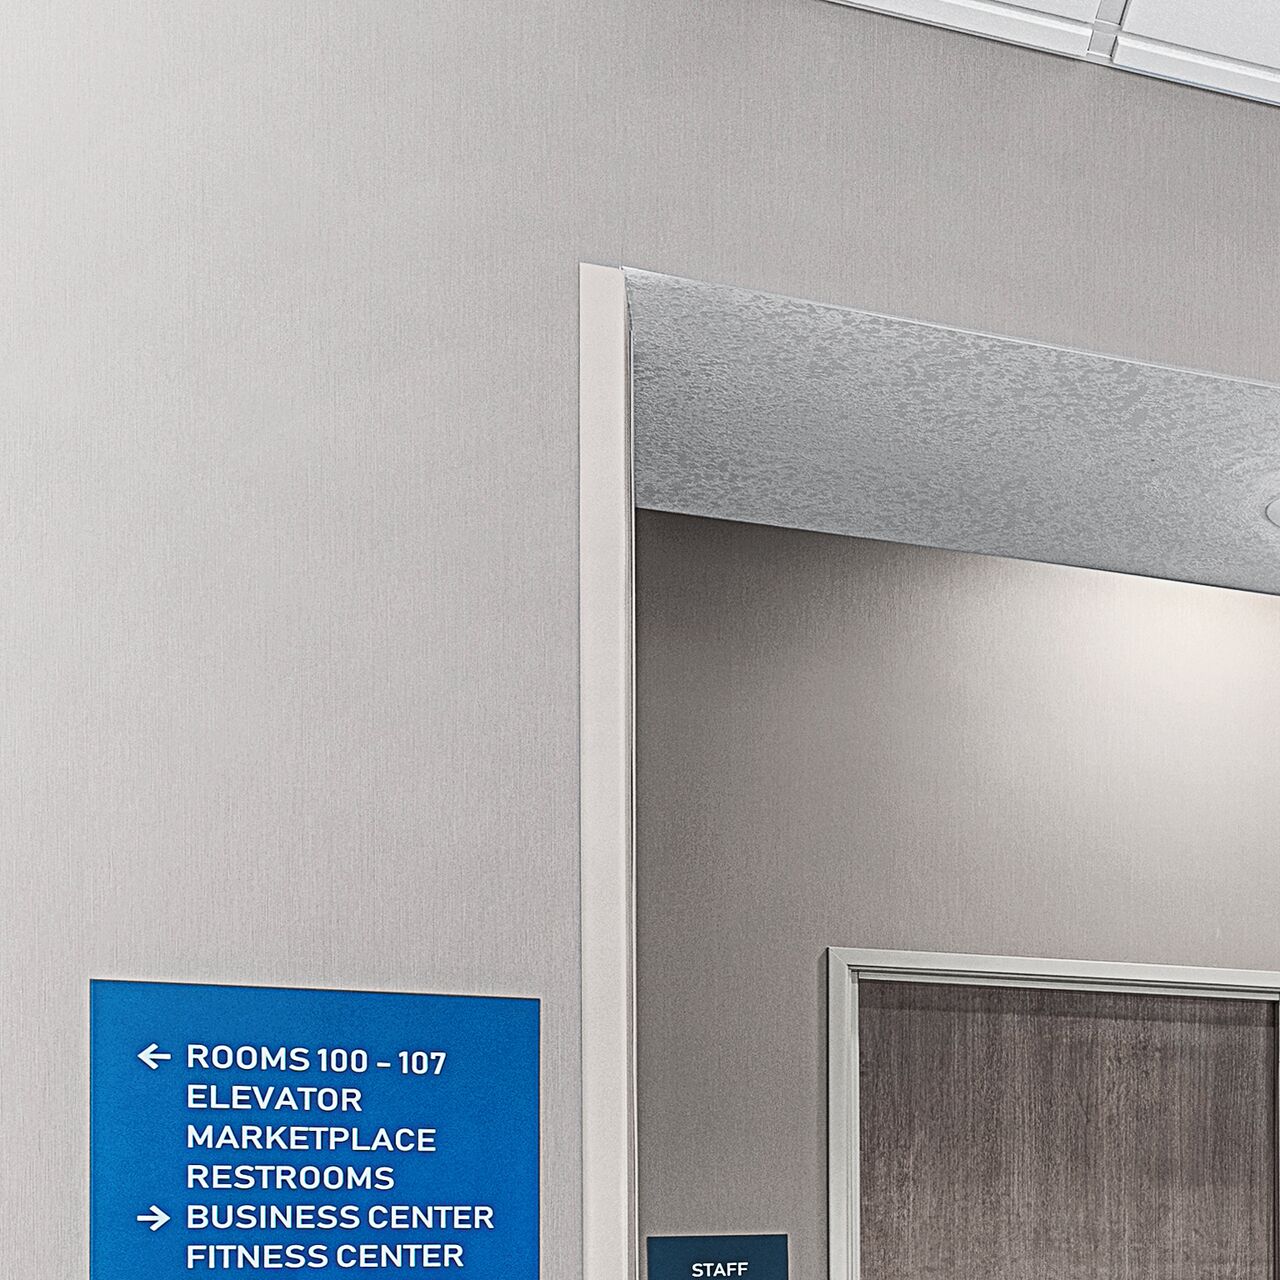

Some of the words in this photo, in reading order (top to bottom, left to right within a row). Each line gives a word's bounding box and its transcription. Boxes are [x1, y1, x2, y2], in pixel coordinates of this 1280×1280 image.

[186, 1043, 310, 1072] ROOMS
[317, 1048, 369, 1074] 100
[398, 1051, 446, 1075] 107
[186, 1084, 362, 1112] ELEVATOR
[186, 1125, 436, 1152] MARKETPLACE
[186, 1165, 395, 1190] RESTROOMS
[186, 1205, 360, 1229] BUSINESS
[368, 1206, 494, 1229] CENTER
[186, 1245, 328, 1269] FITNESS
[336, 1244, 464, 1267] CENTER
[692, 1262, 748, 1278] STAFF
